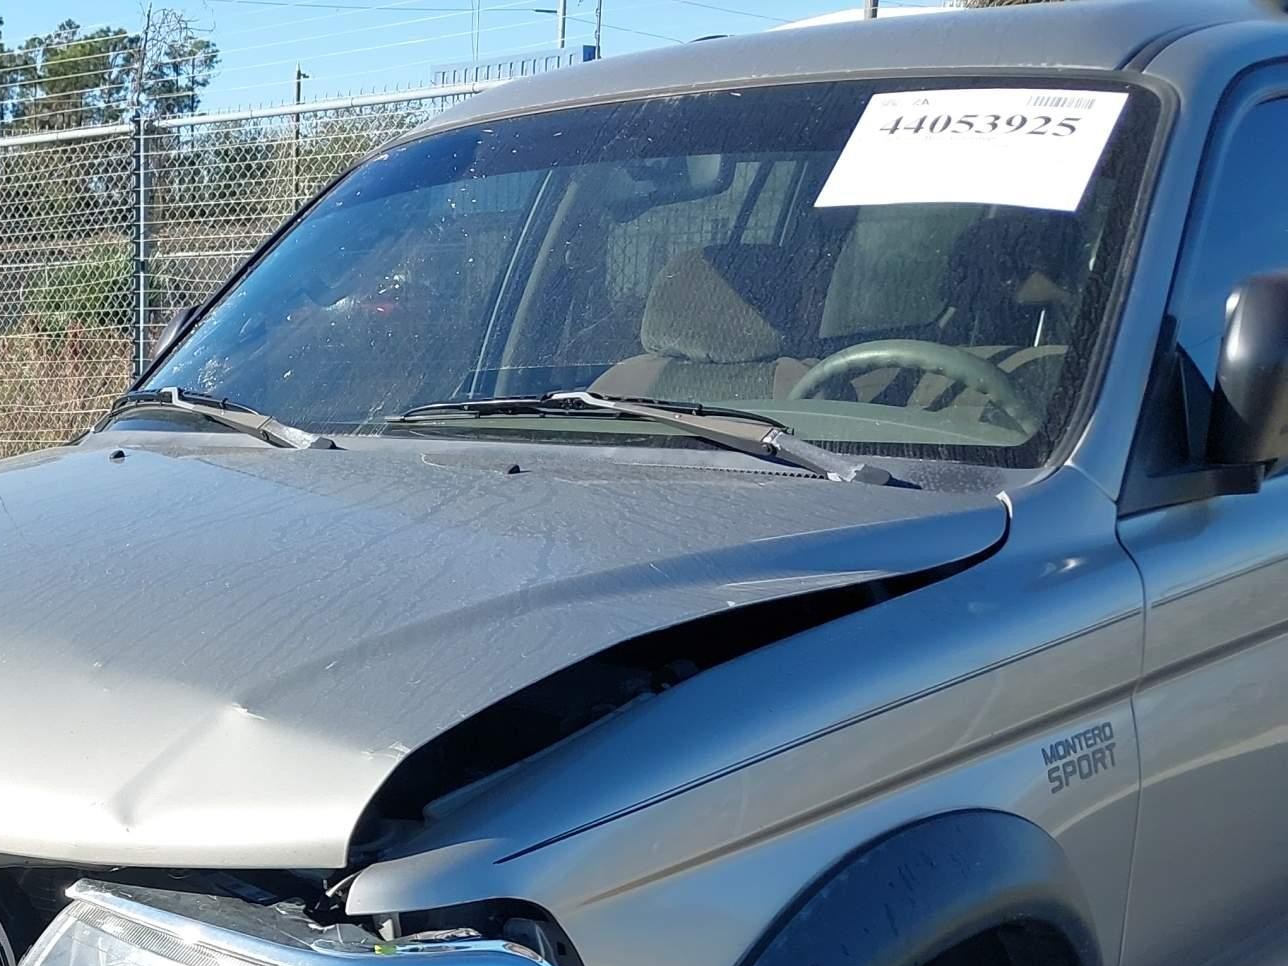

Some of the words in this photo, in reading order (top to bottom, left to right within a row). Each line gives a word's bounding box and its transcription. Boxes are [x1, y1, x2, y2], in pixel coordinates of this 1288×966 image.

[879, 113, 1083, 137] 44053925
[1041, 721, 1114, 767] MONTERO
[1047, 742, 1116, 794] SPORT
